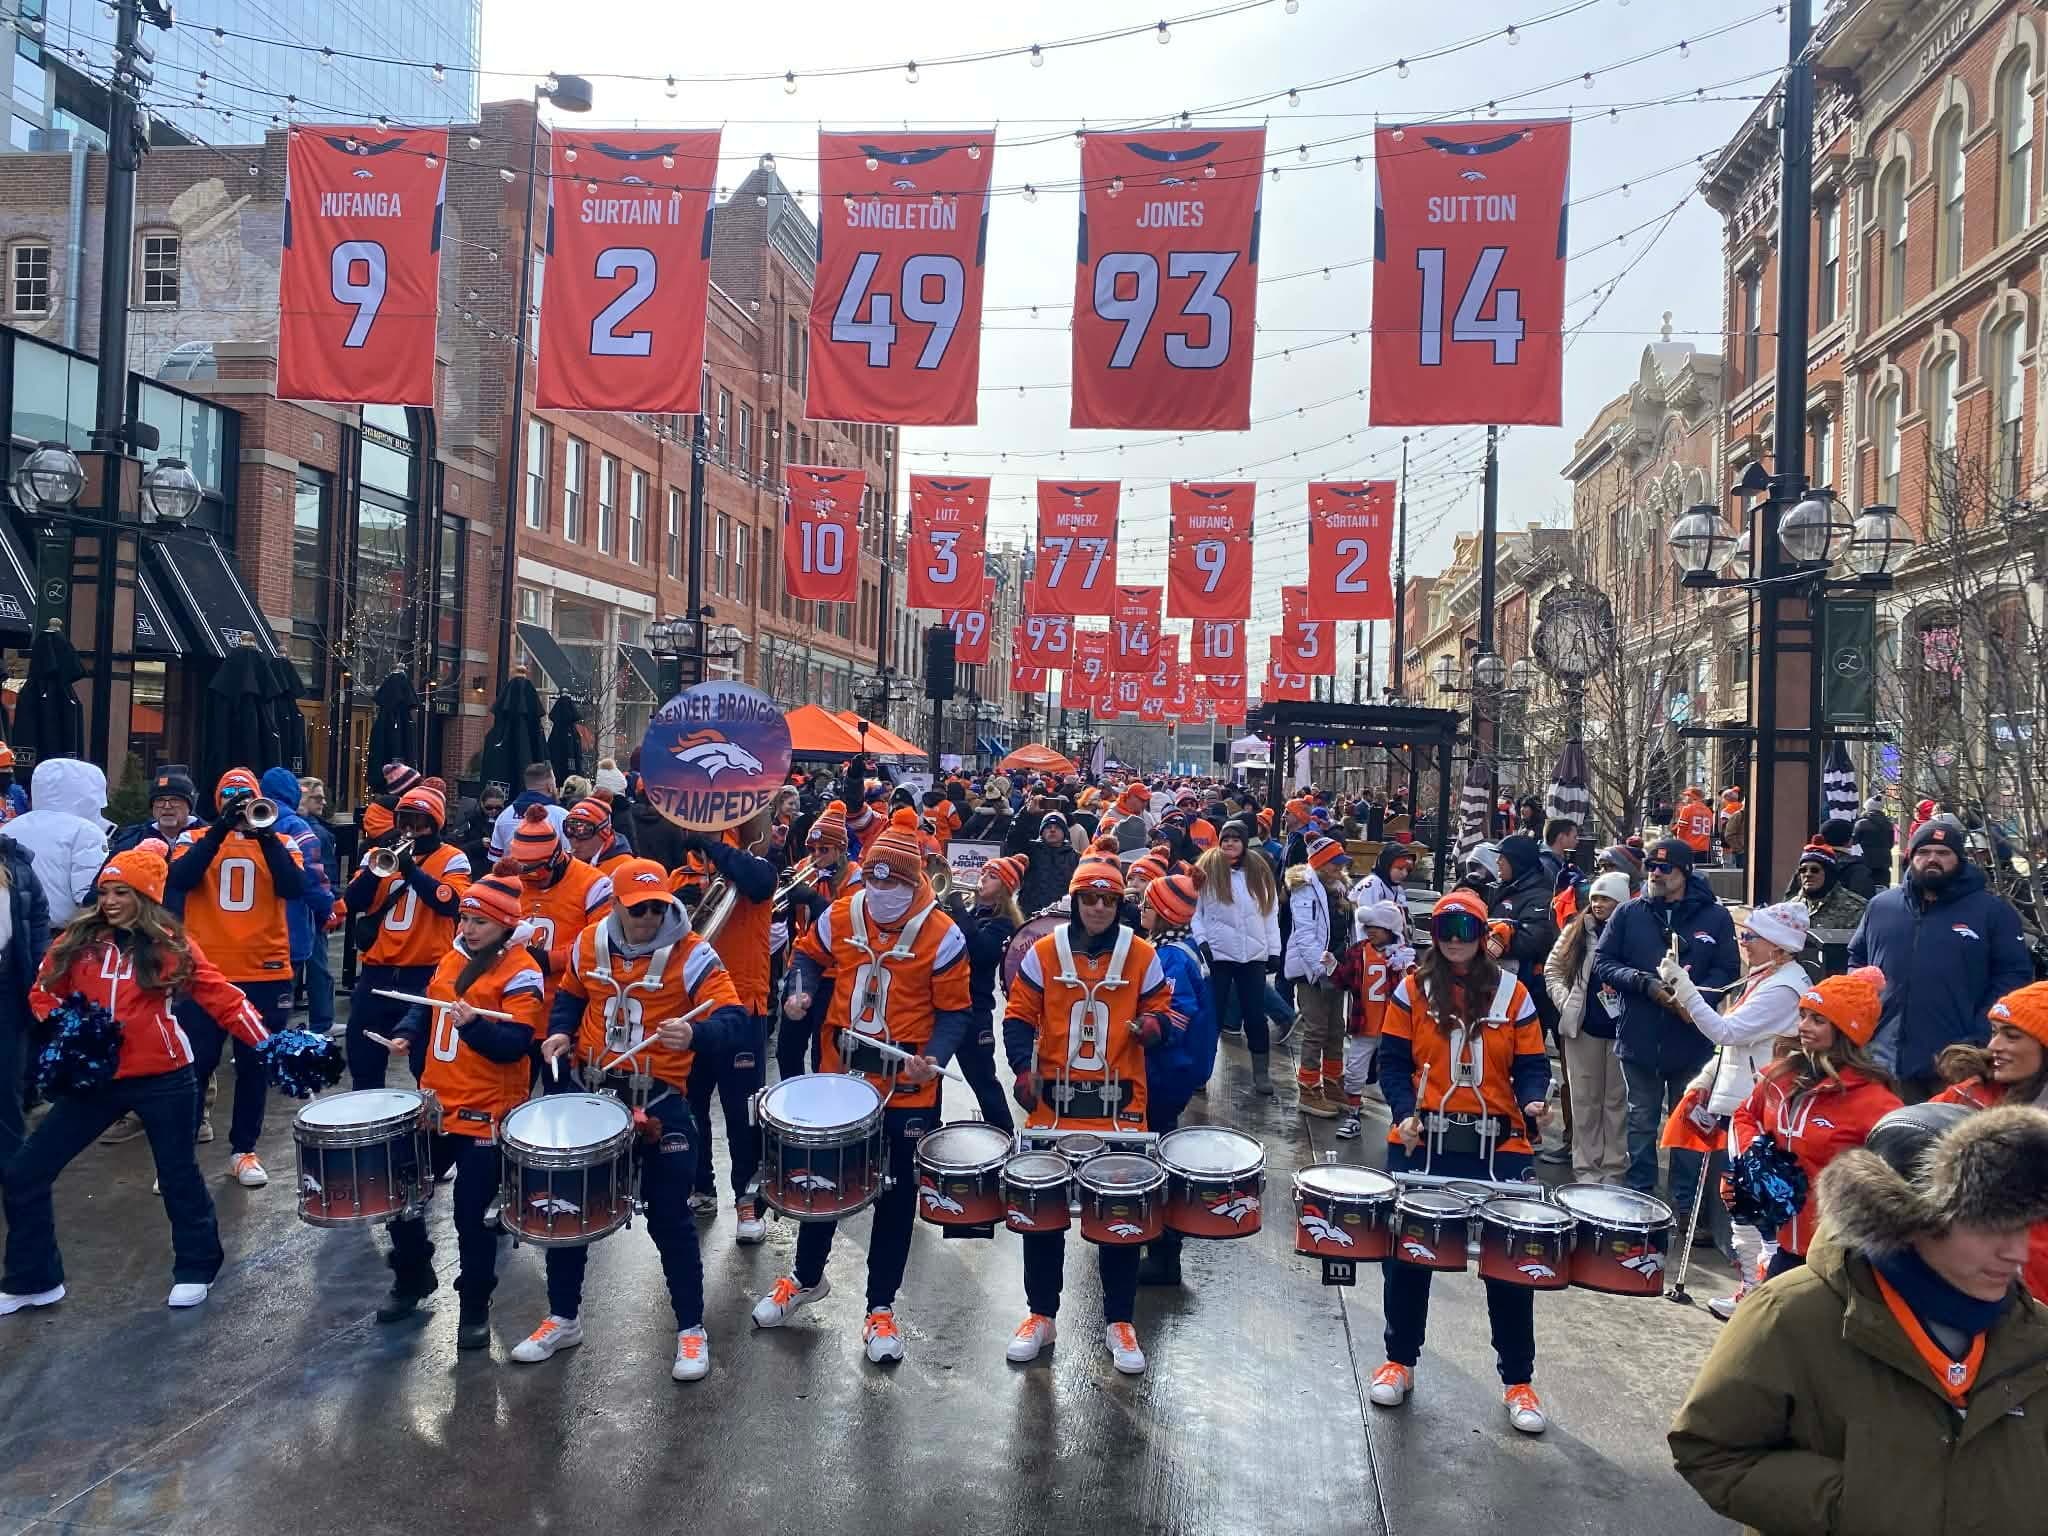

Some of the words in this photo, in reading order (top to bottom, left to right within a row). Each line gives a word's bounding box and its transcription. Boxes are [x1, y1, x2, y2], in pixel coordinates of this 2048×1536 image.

[1919, 8, 1970, 70] GALLUP
[320, 191, 402, 218] HUFANGA
[580, 198, 662, 226] SURTAIN
[668, 198, 680, 226] II
[846, 200, 957, 231] SINGLETON
[1136, 200, 1205, 229] JONES
[1428, 194, 1517, 223] SUTTON
[330, 240, 388, 348] 9
[588, 246, 658, 357] 2
[830, 251, 966, 370] 49
[1093, 250, 1240, 369] 93
[1416, 245, 1526, 366] 14
[935, 508, 960, 521] LUTZ
[1056, 513, 1099, 527] MEINERZ
[1189, 516, 1234, 529] HUFANGA
[1326, 514, 1369, 529] SURTAIN
[800, 520, 845, 575] 10
[928, 530, 962, 584] 3
[1043, 535, 1109, 589] 77
[1195, 539, 1227, 593] 9
[1336, 538, 1369, 593] 2
[947, 609, 985, 646] 49
[1026, 617, 1068, 652] 93
[1118, 621, 1150, 656] 14
[1203, 623, 1235, 659] 10
[1297, 622, 1321, 658] 3
[1086, 658, 1102, 683] 9
[1101, 695, 1112, 712] 2
[1119, 681, 1138, 702] 10
[654, 694, 711, 726] DENVER
[717, 693, 786, 728] BRONCOS
[650, 789, 771, 825] STAMPEDE
[1691, 815, 1712, 836] 58
[219, 857, 257, 913] 0
[1083, 1027, 1094, 1037] M
[1461, 1064, 1472, 1075] M
